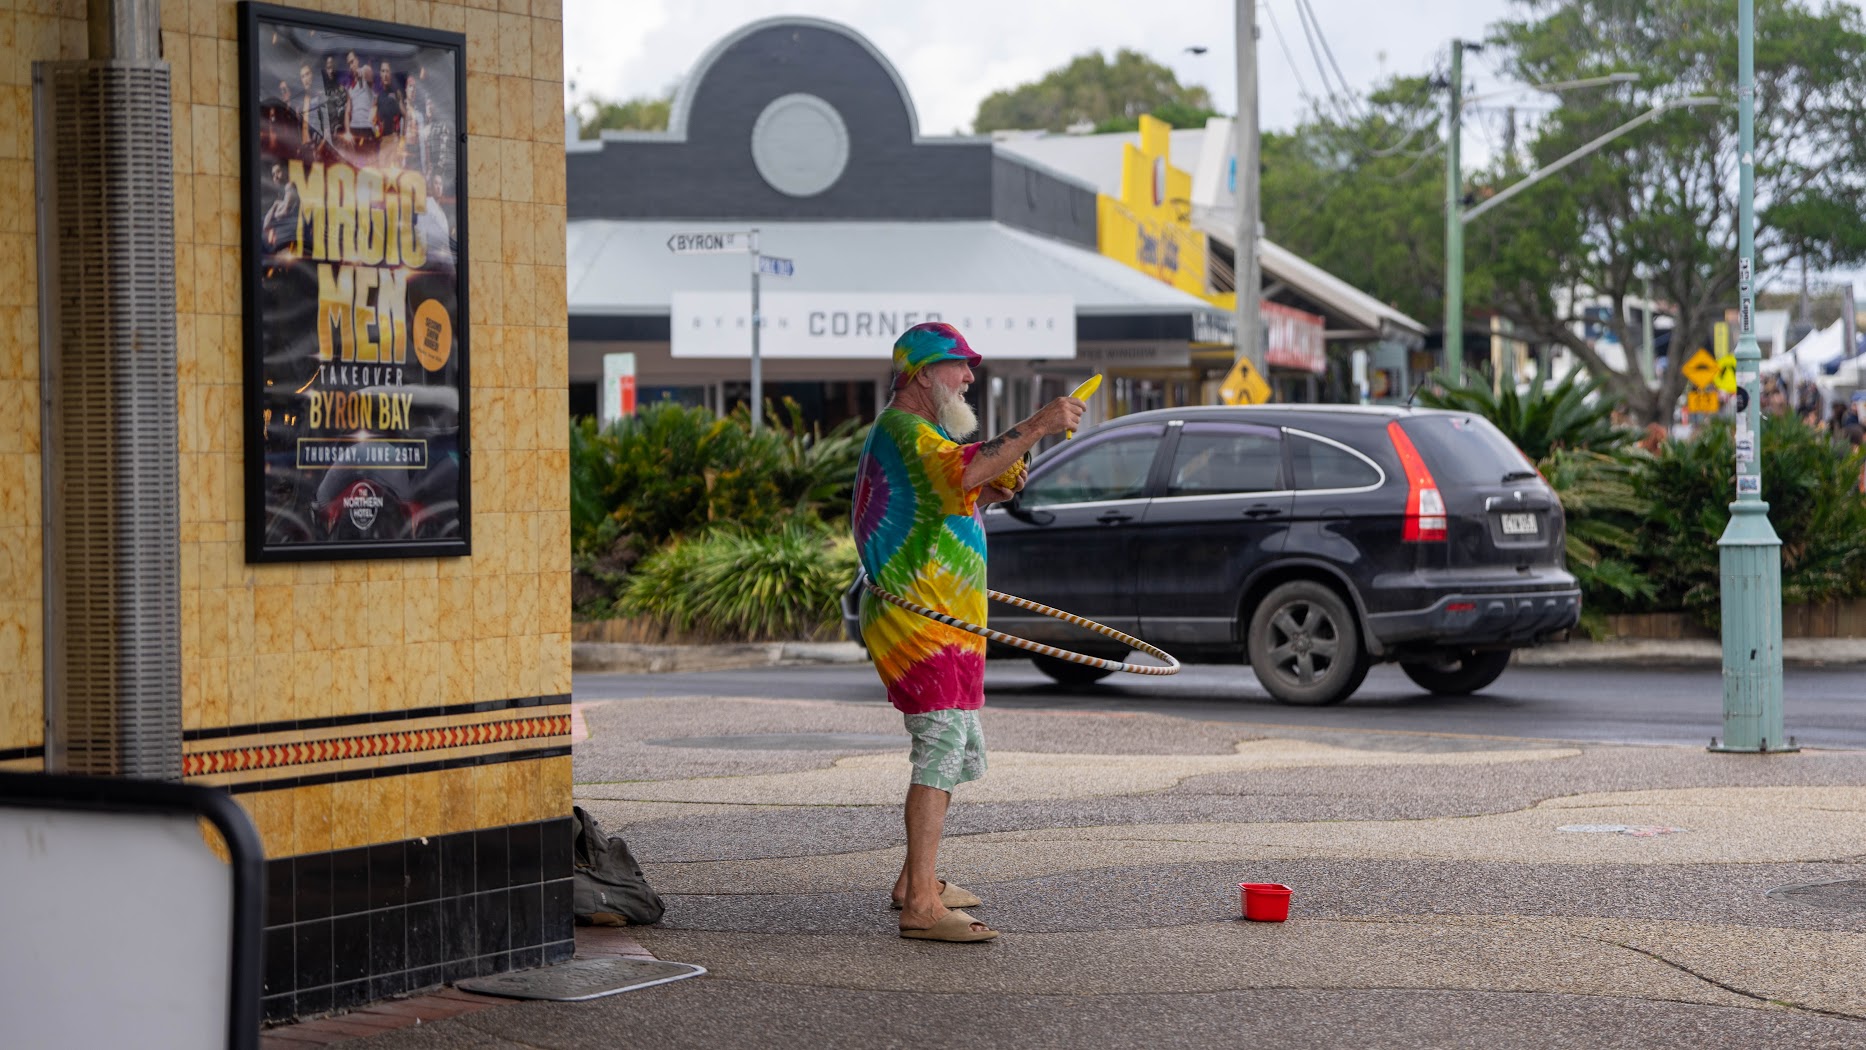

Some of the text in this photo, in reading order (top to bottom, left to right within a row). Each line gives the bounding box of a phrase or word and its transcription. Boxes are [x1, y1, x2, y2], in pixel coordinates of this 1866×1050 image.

[677, 234, 723, 251] BYRON
[317, 263, 407, 364] MEN
[963, 316, 1055, 329] STORE
[320, 365, 403, 387] TAKEOVER
[310, 389, 413, 430] BYRON BAY
[305, 446, 360, 464] THURSDAY,
[366, 447, 389, 462] JUNE
[343, 496, 384, 508] NORTHERN
[353, 508, 374, 518] HOTEL
